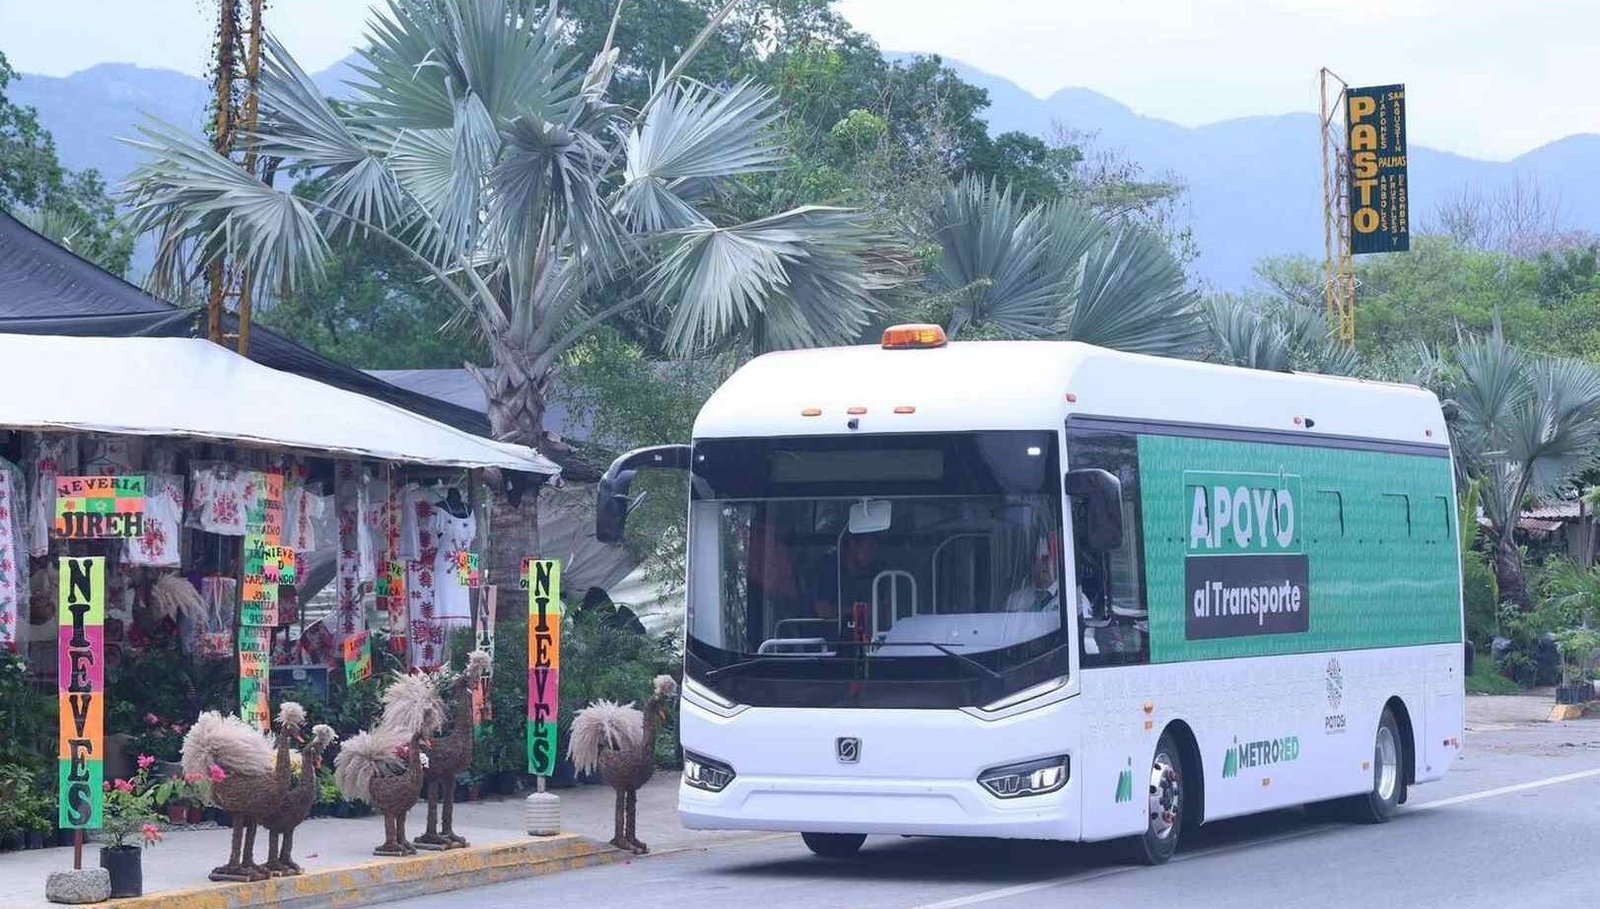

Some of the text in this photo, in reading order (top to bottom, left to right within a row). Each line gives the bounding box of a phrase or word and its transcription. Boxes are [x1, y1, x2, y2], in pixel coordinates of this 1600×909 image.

[1379, 94, 1387, 149] JAPONES
[1349, 96, 1379, 233] PASTO
[1378, 156, 1406, 168] PALMAS
[1380, 175, 1388, 232] ARBOLES
[58, 478, 141, 497] NEVERIA
[56, 512, 143, 538] JIREH
[1190, 485, 1294, 549] APOYO
[1194, 580, 1301, 625] al Transporte
[67, 559, 95, 826] NIEVES
[533, 561, 553, 773] NIEVES
[1239, 736, 1300, 769] METRORED
